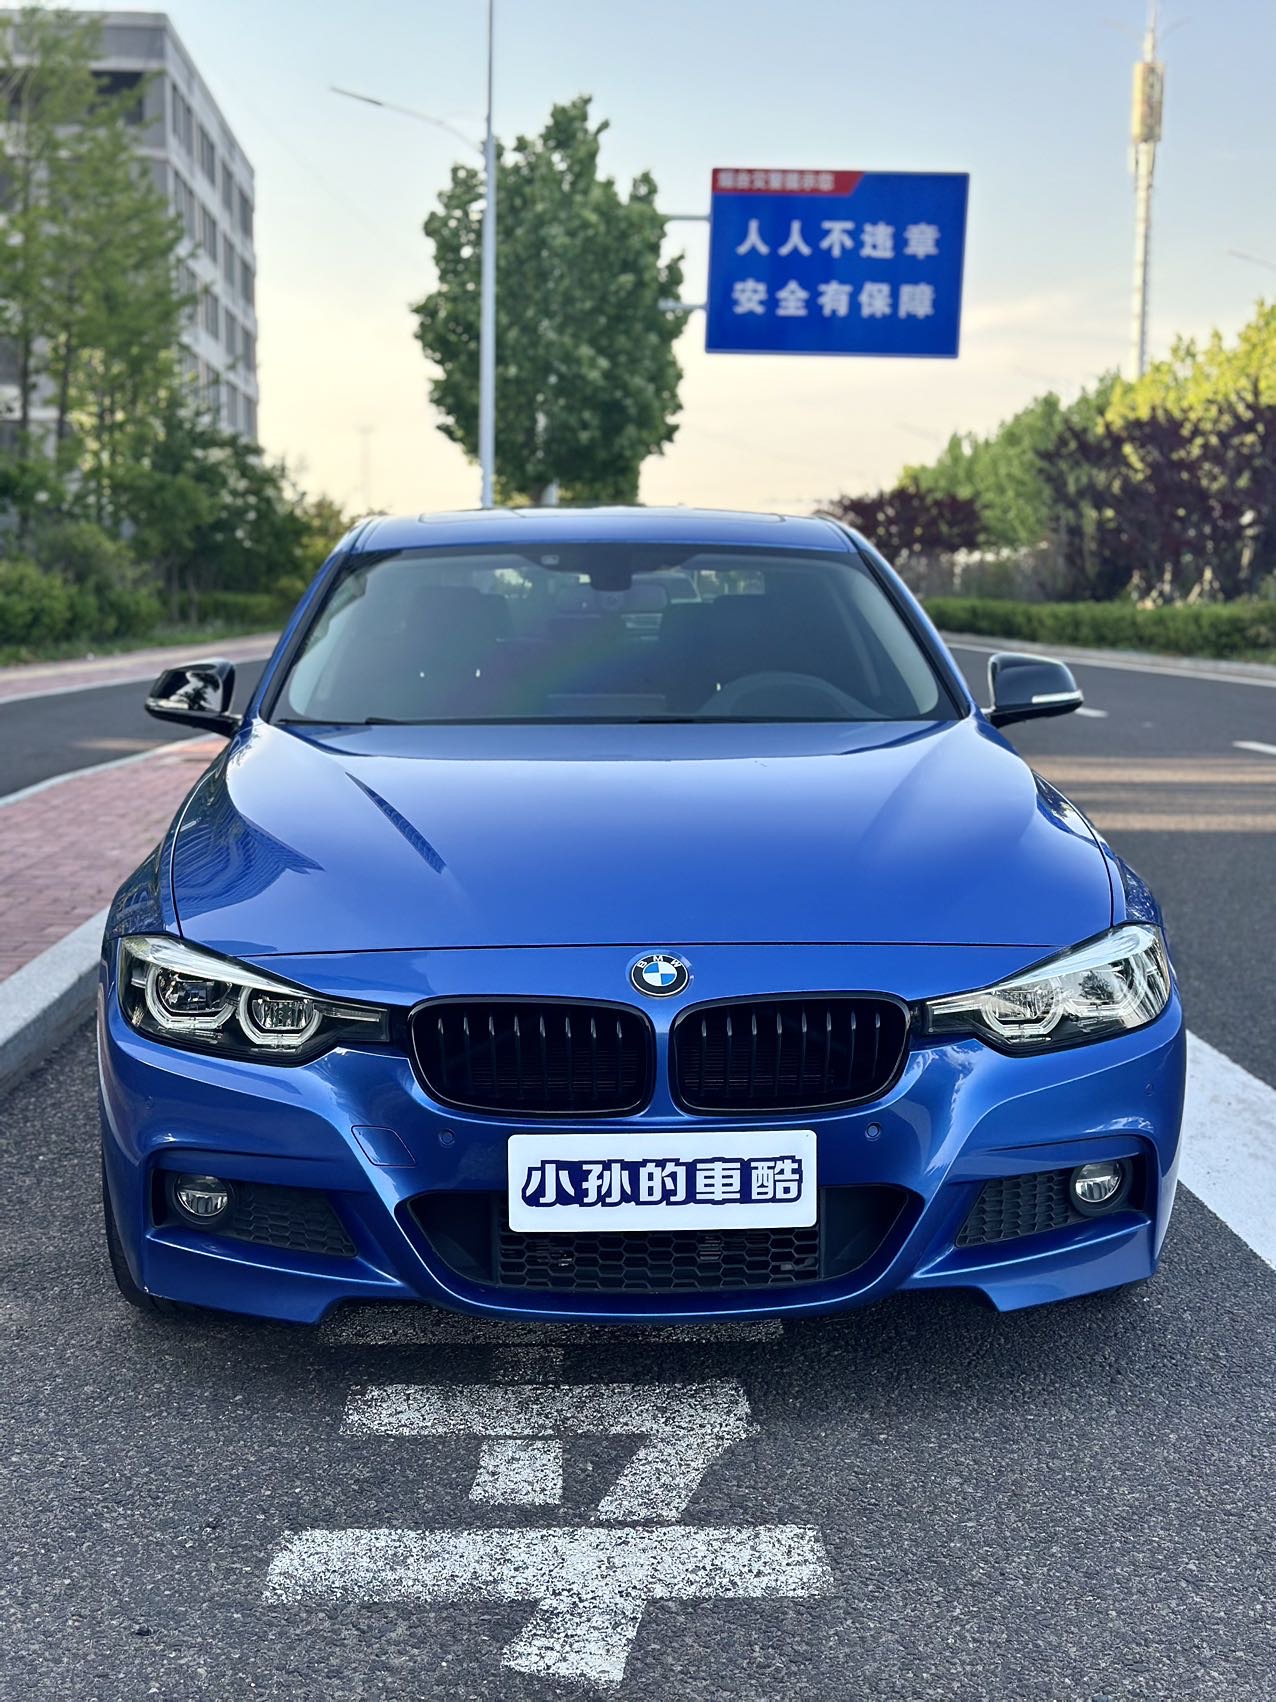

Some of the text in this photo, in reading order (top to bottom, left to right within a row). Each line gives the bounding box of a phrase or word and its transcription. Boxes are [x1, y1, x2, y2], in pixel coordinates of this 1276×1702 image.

[736, 219, 940, 259] 人人不违章
[731, 278, 935, 319] 安全有保障
[637, 954, 682, 968] BMW
[523, 1157, 802, 1206] 小孙的車酷
